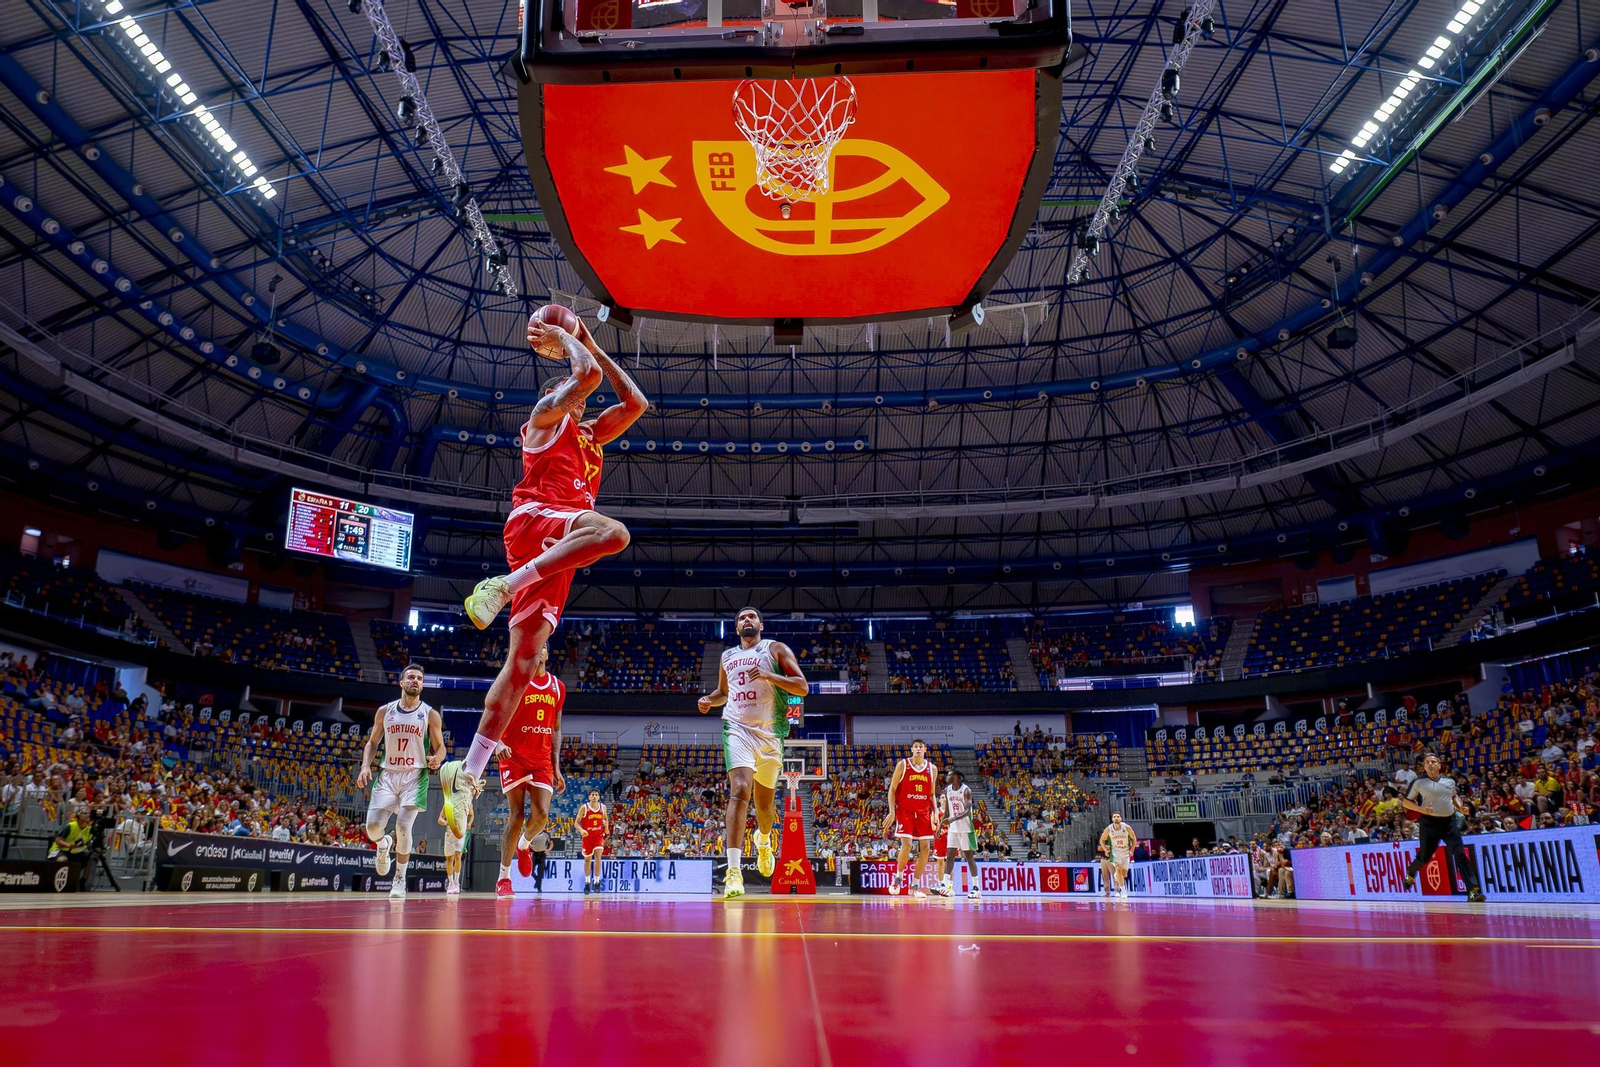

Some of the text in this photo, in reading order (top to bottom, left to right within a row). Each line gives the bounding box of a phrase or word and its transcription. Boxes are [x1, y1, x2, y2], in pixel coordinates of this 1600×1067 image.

[708, 152, 737, 191] FEB
[339, 501, 350, 510] 11
[358, 505, 369, 514] 20
[343, 524, 364, 536] 1:49
[727, 657, 761, 673] PORTUGAL
[524, 693, 556, 708] ESPAÑA
[536, 709, 545, 721] 8
[786, 705, 801, 718] 24
[387, 724, 423, 738] PORTUGAL
[397, 738, 409, 752] 17
[389, 757, 415, 766] una
[196, 844, 228, 858] endesa
[1209, 857, 1233, 876] ENTRADAS
[1238, 855, 1246, 876] LA
[1362, 842, 1418, 893] ESPAÑA
[1481, 839, 1585, 894] ALEMANIA
[778, 877, 810, 886] CaixaBank
[981, 862, 1036, 891] ESPAÑA
[1211, 877, 1226, 896] VENTA
